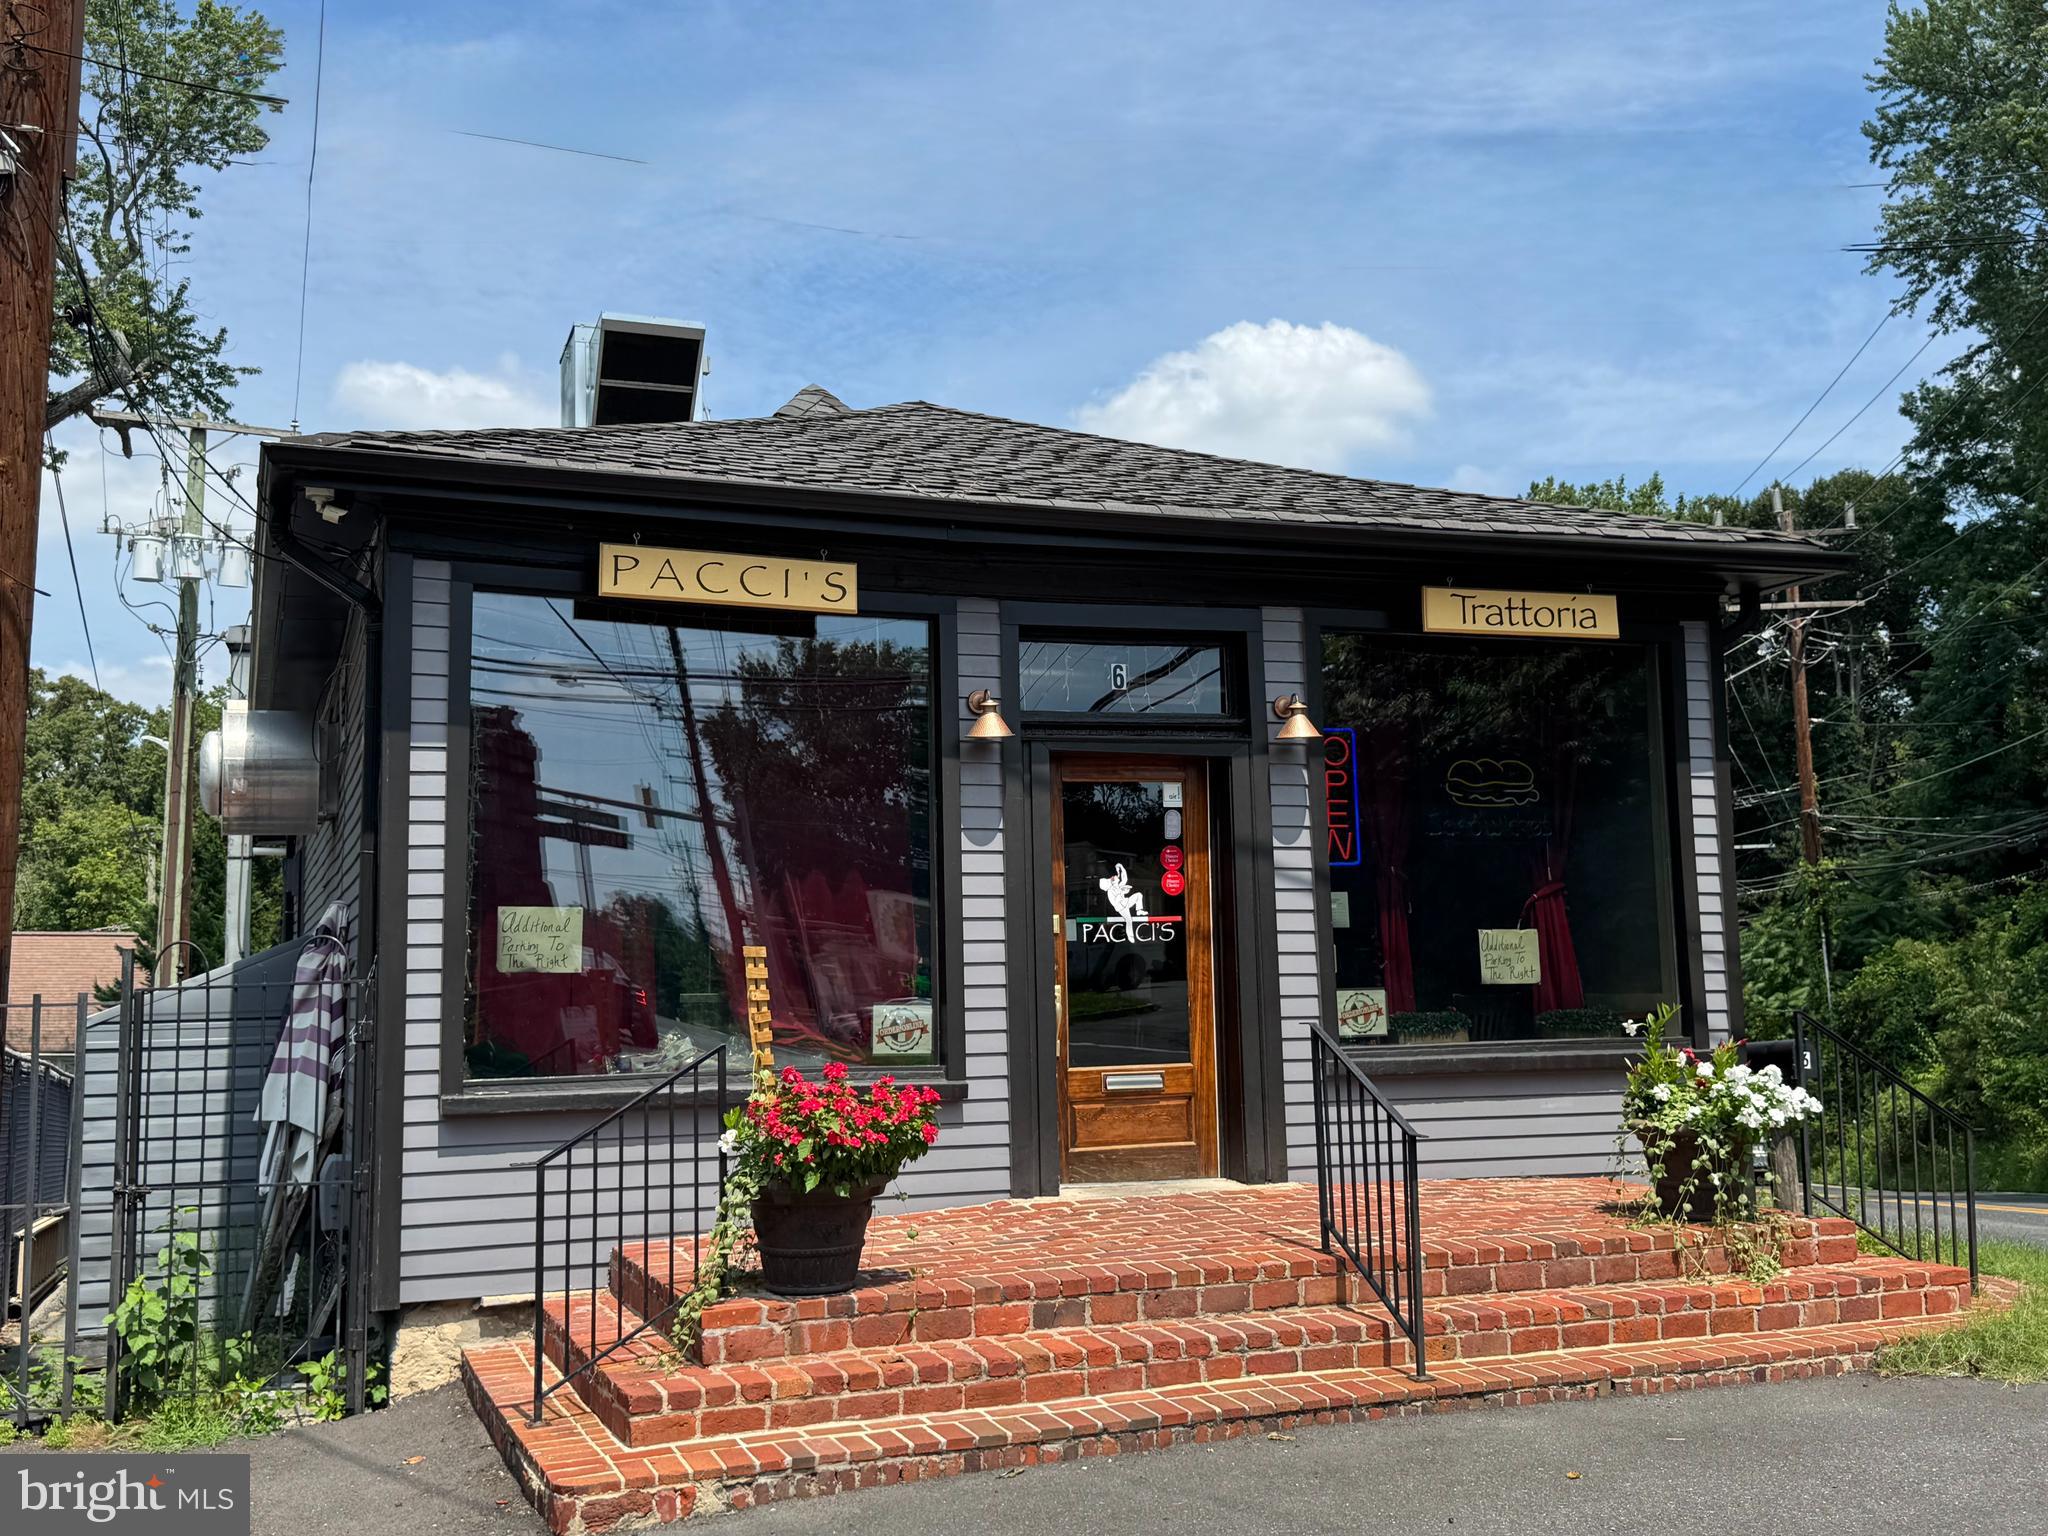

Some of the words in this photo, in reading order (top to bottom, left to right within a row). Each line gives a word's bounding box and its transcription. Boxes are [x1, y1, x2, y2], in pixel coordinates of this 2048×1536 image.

[612, 553, 848, 603] PACCI'S
[1449, 592, 1598, 630] Trattoria
[1112, 664, 1125, 690] 6
[1323, 736, 1352, 860] OPEN
[501, 911, 571, 934] Additional
[1082, 922, 1175, 943] PACCI'S
[501, 935, 539, 955] Parking
[548, 935, 564, 951] To
[503, 953, 526, 969] The
[534, 953, 569, 969] Right
[1515, 951, 1526, 964] To
[1485, 966, 1503, 980] The
[1509, 965, 1536, 980] Right
